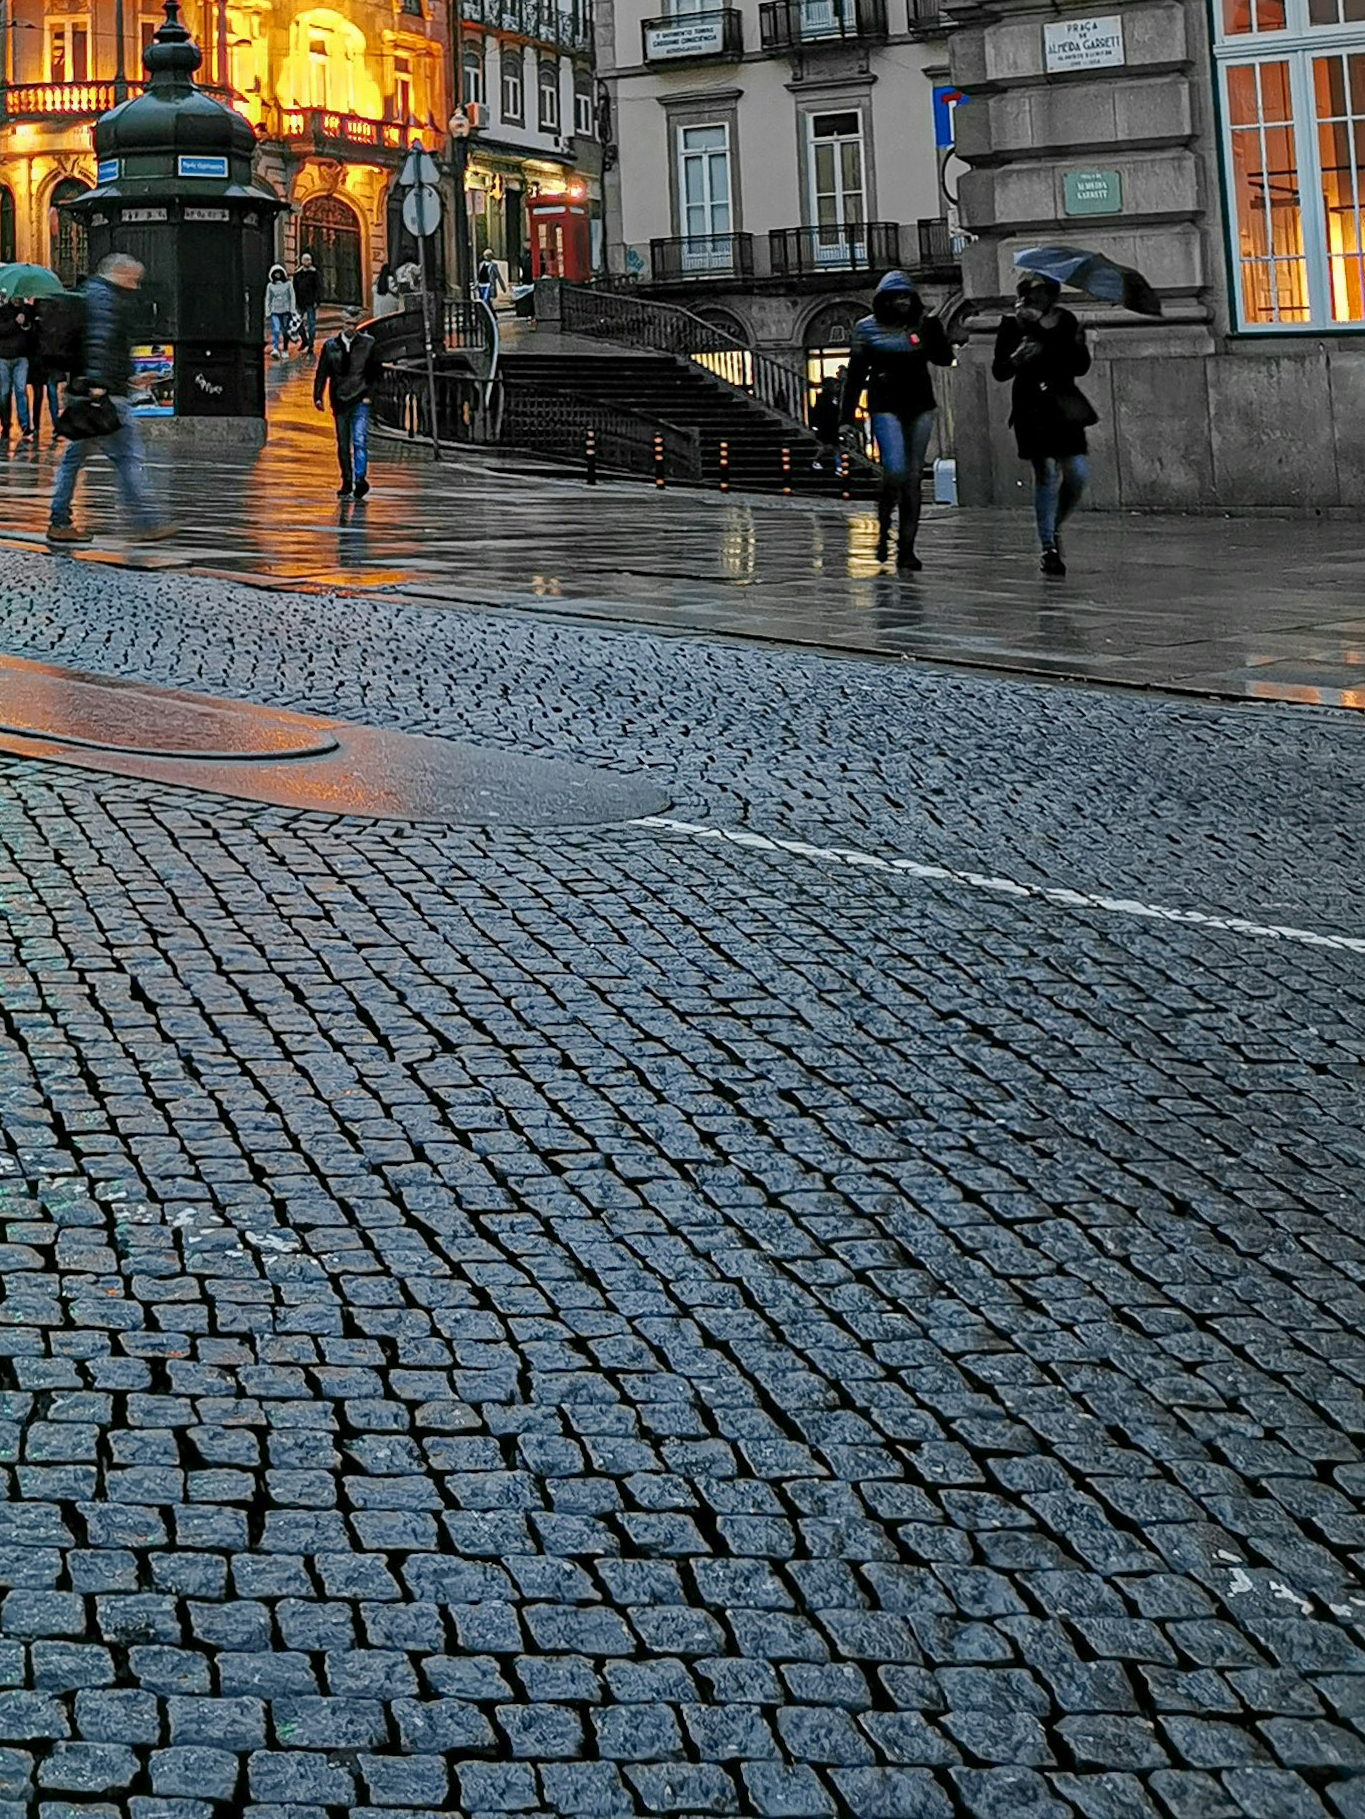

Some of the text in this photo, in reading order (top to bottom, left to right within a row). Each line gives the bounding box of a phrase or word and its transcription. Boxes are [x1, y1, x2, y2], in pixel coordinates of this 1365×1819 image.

[1066, 21, 1098, 33] PRAÇA
[1048, 35, 1120, 55] ALMEIDA GARRETT
